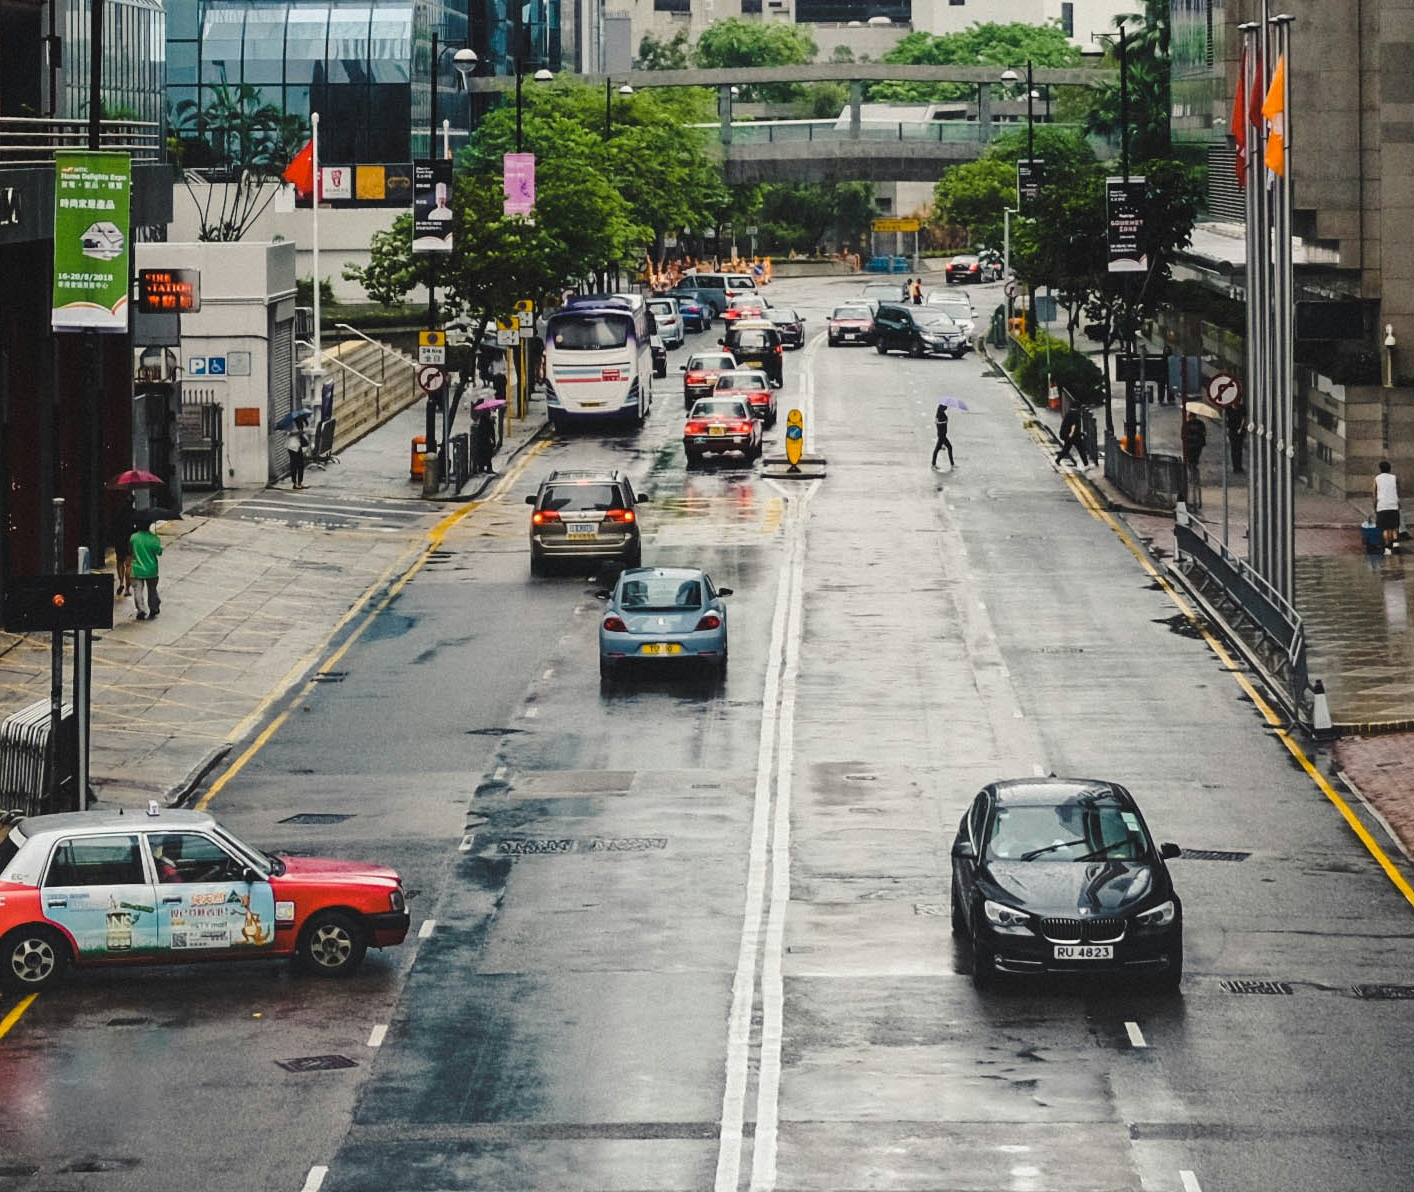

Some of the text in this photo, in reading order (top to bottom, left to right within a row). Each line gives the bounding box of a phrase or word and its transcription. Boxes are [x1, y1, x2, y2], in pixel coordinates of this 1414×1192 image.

[145, 273, 171, 283] FIRE
[191, 359, 205, 372] P
[1057, 947, 1110, 958] RU 4823
